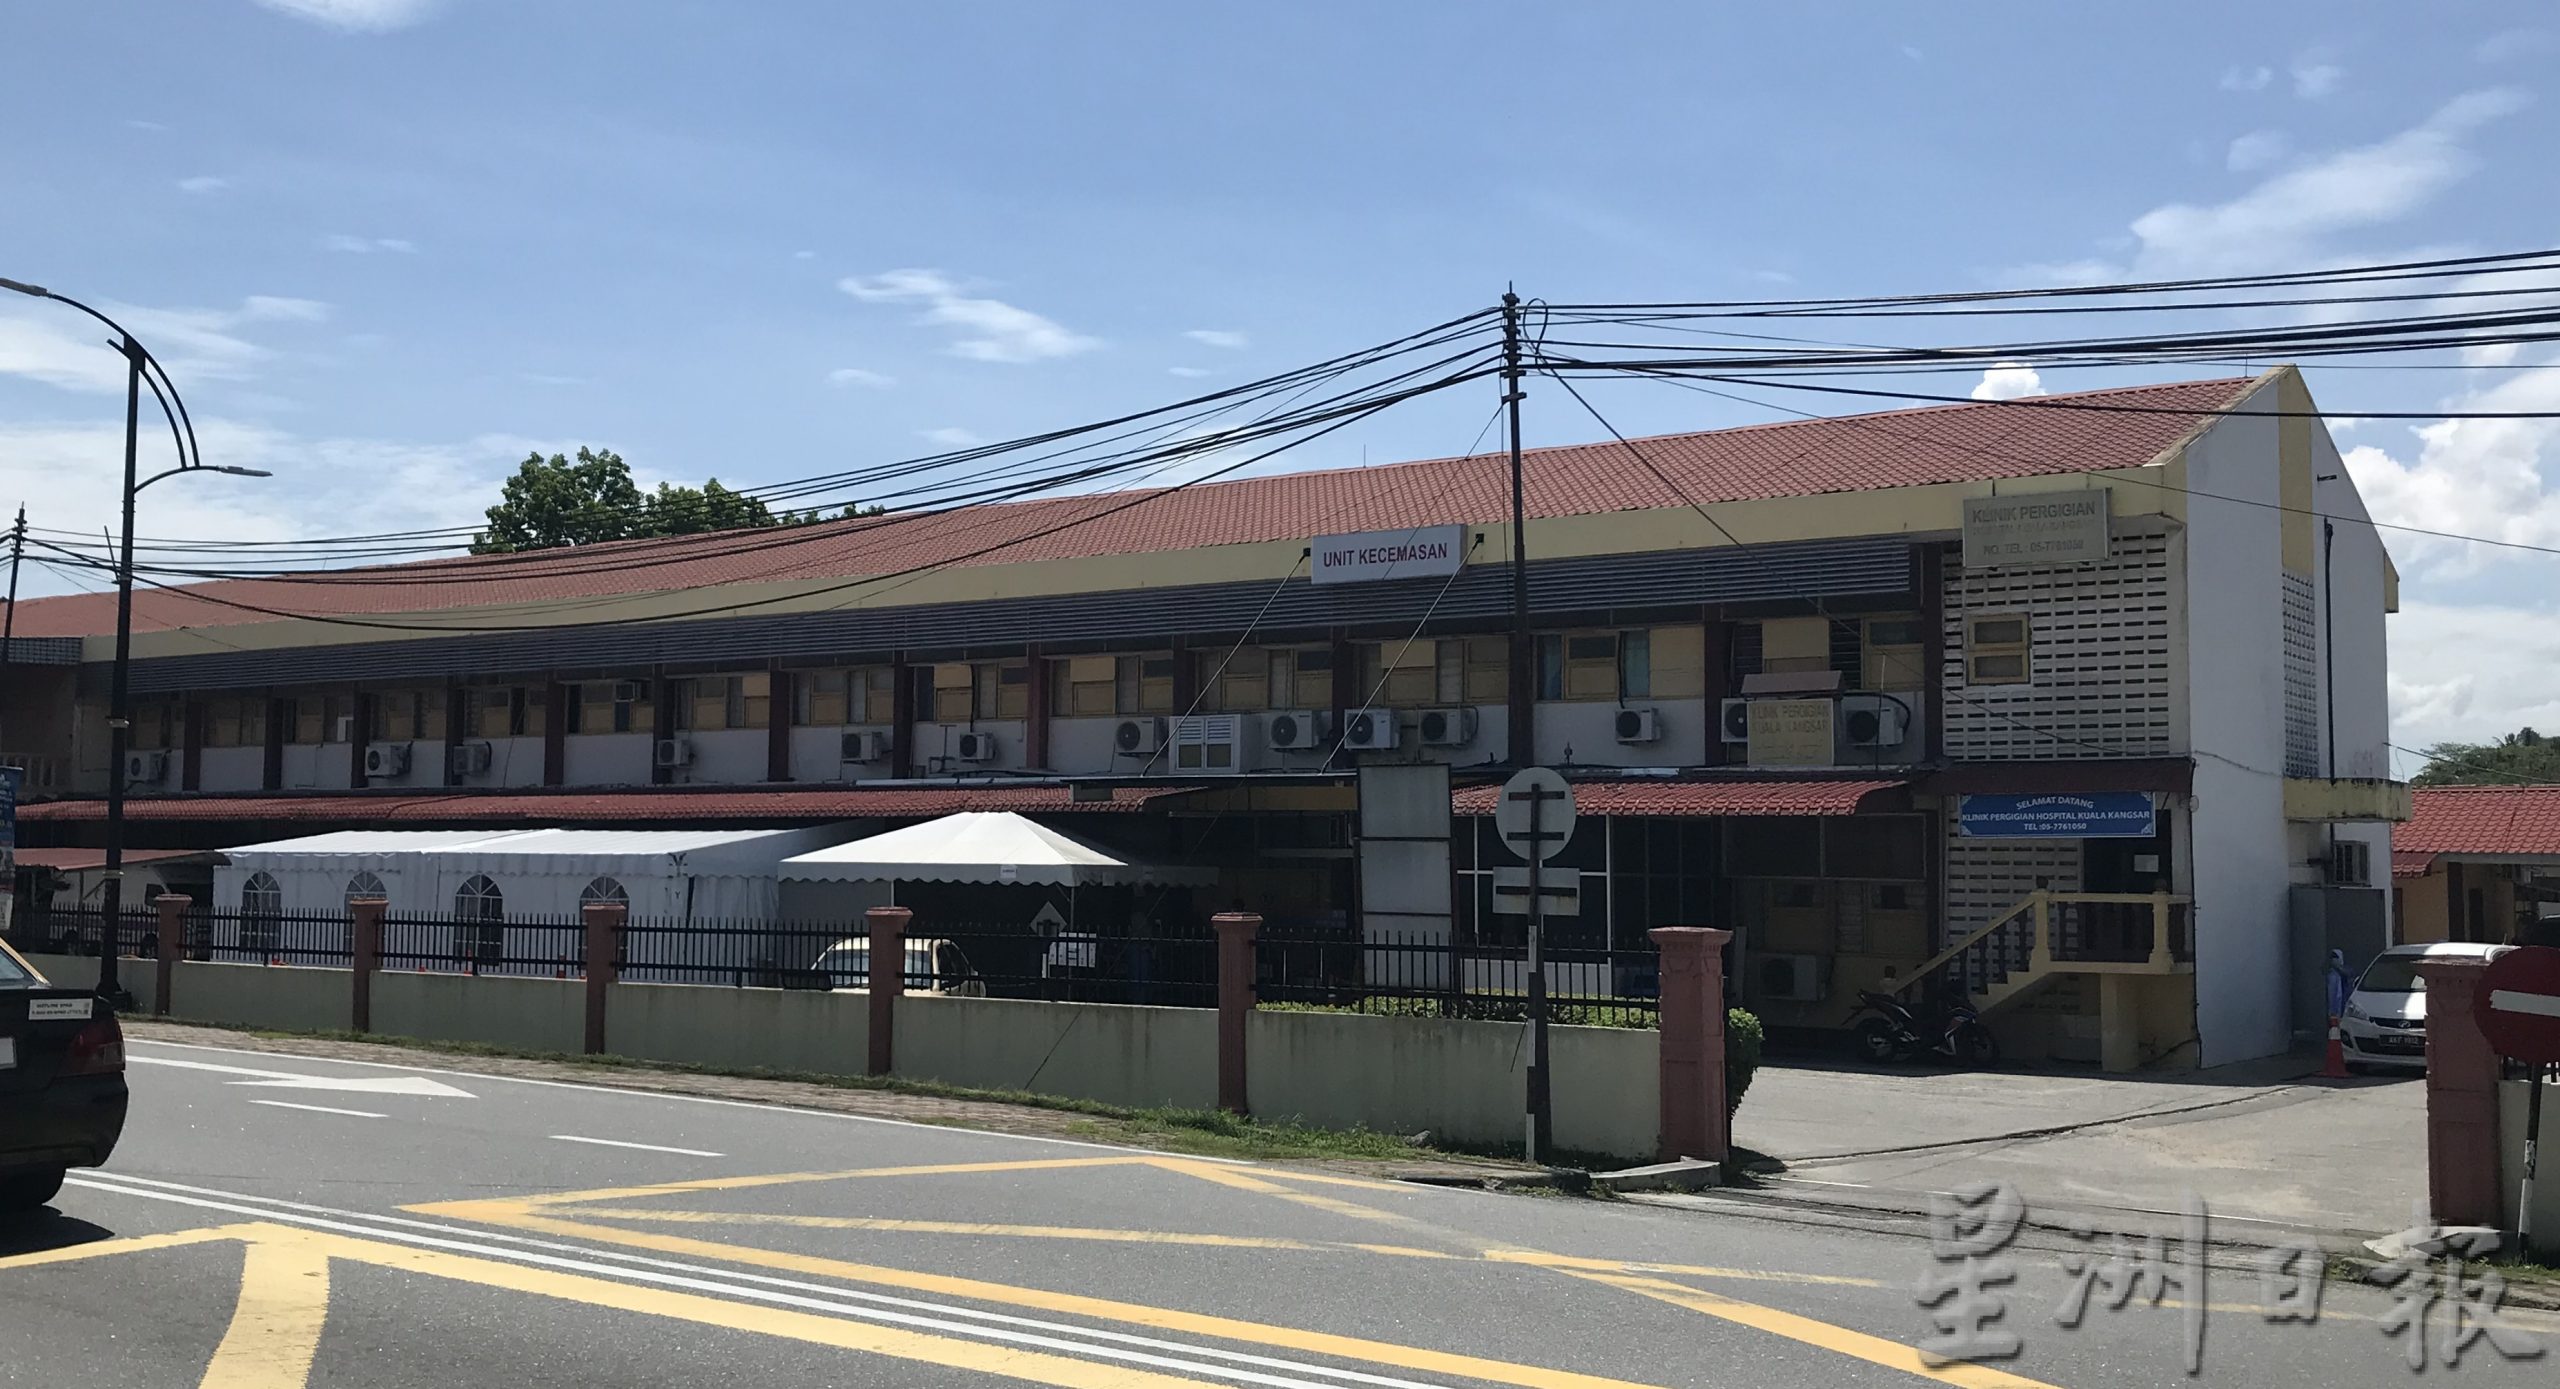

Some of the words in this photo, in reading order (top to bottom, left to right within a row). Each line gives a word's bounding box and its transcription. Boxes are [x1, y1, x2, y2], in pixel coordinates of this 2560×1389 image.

[2020, 501, 2095, 519] PERGIGIAN
[1323, 550, 1355, 567] UNIT
[1359, 543, 1448, 565] KECEMASAN
[2016, 796, 2057, 810] SELAMAT
[2057, 797, 2095, 810] DATANG
[1962, 814, 1989, 822] KLINIK
[1990, 813, 2035, 821] PERGIGIAN
[2036, 812, 2076, 820] HOSPITAL
[2078, 812, 2107, 820] KUALA
[2108, 811, 2150, 819] KANGSAR
[2024, 823, 2038, 831] TEL
